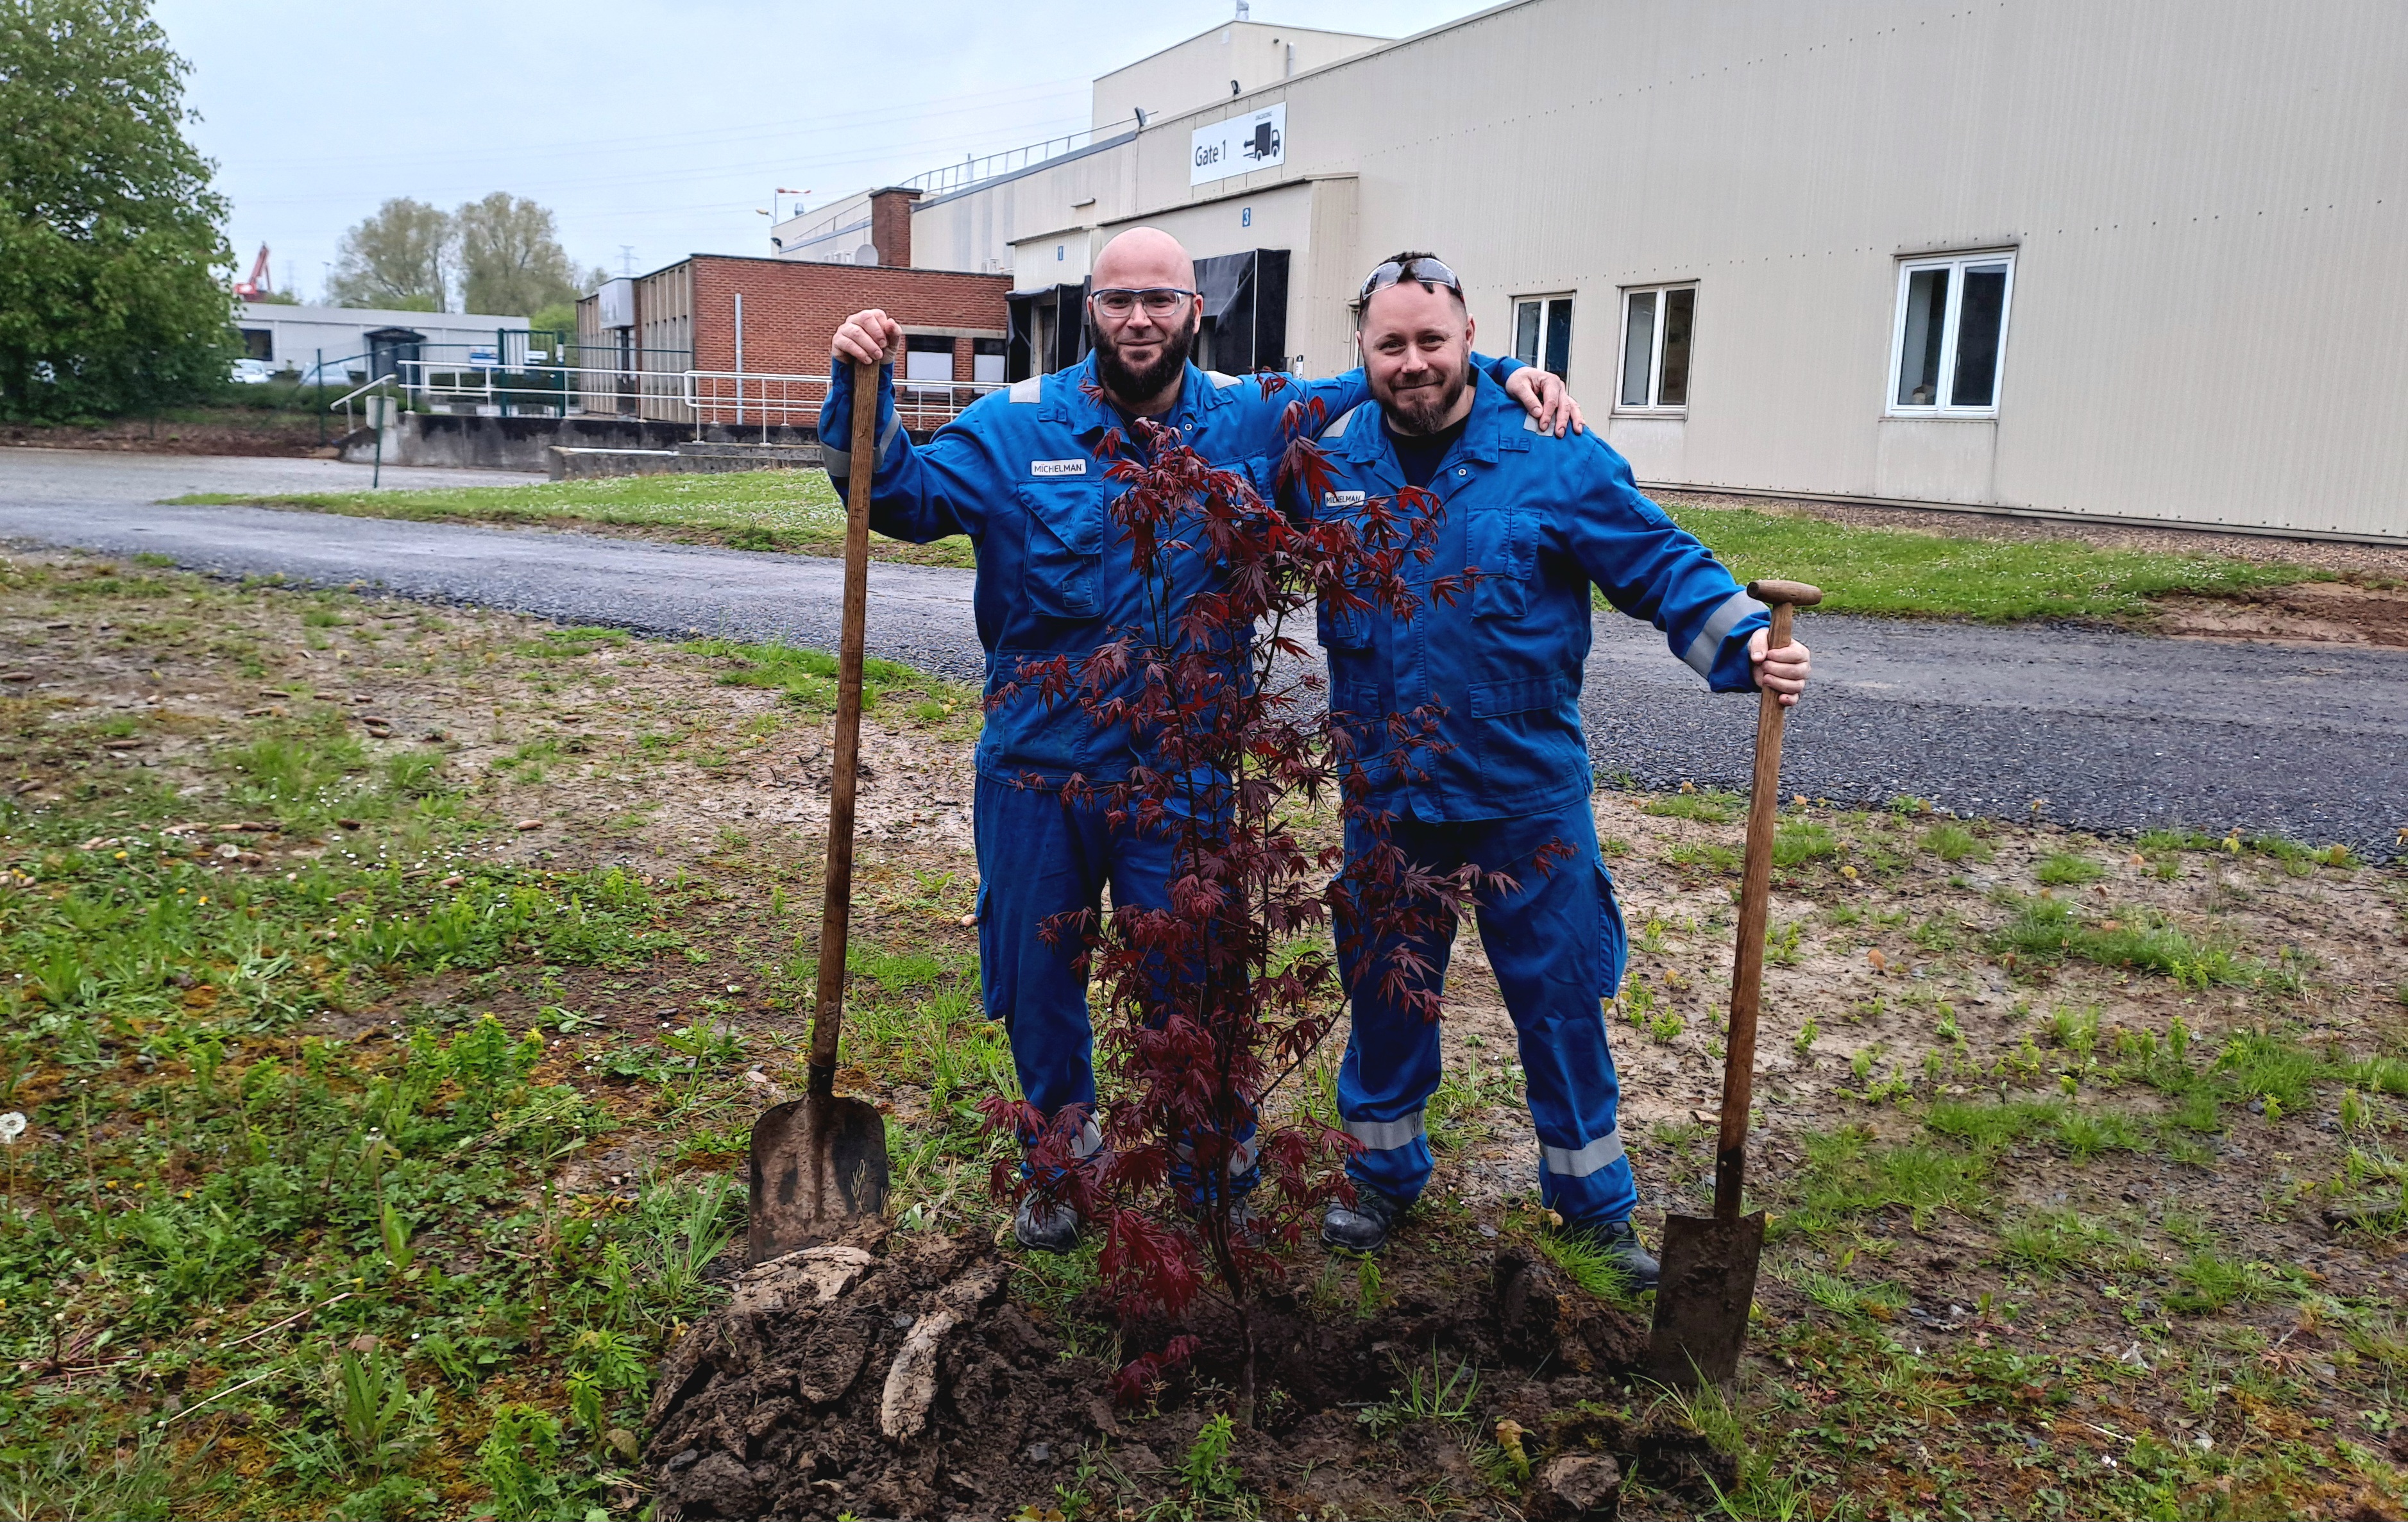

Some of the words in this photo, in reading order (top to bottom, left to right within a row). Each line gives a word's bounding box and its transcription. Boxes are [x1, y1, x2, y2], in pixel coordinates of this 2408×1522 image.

[1195, 145, 1219, 167] Gate
[1222, 139, 1226, 160] 1
[1244, 208, 1250, 226] 3
[1034, 463, 1082, 473] MICHELMAN
